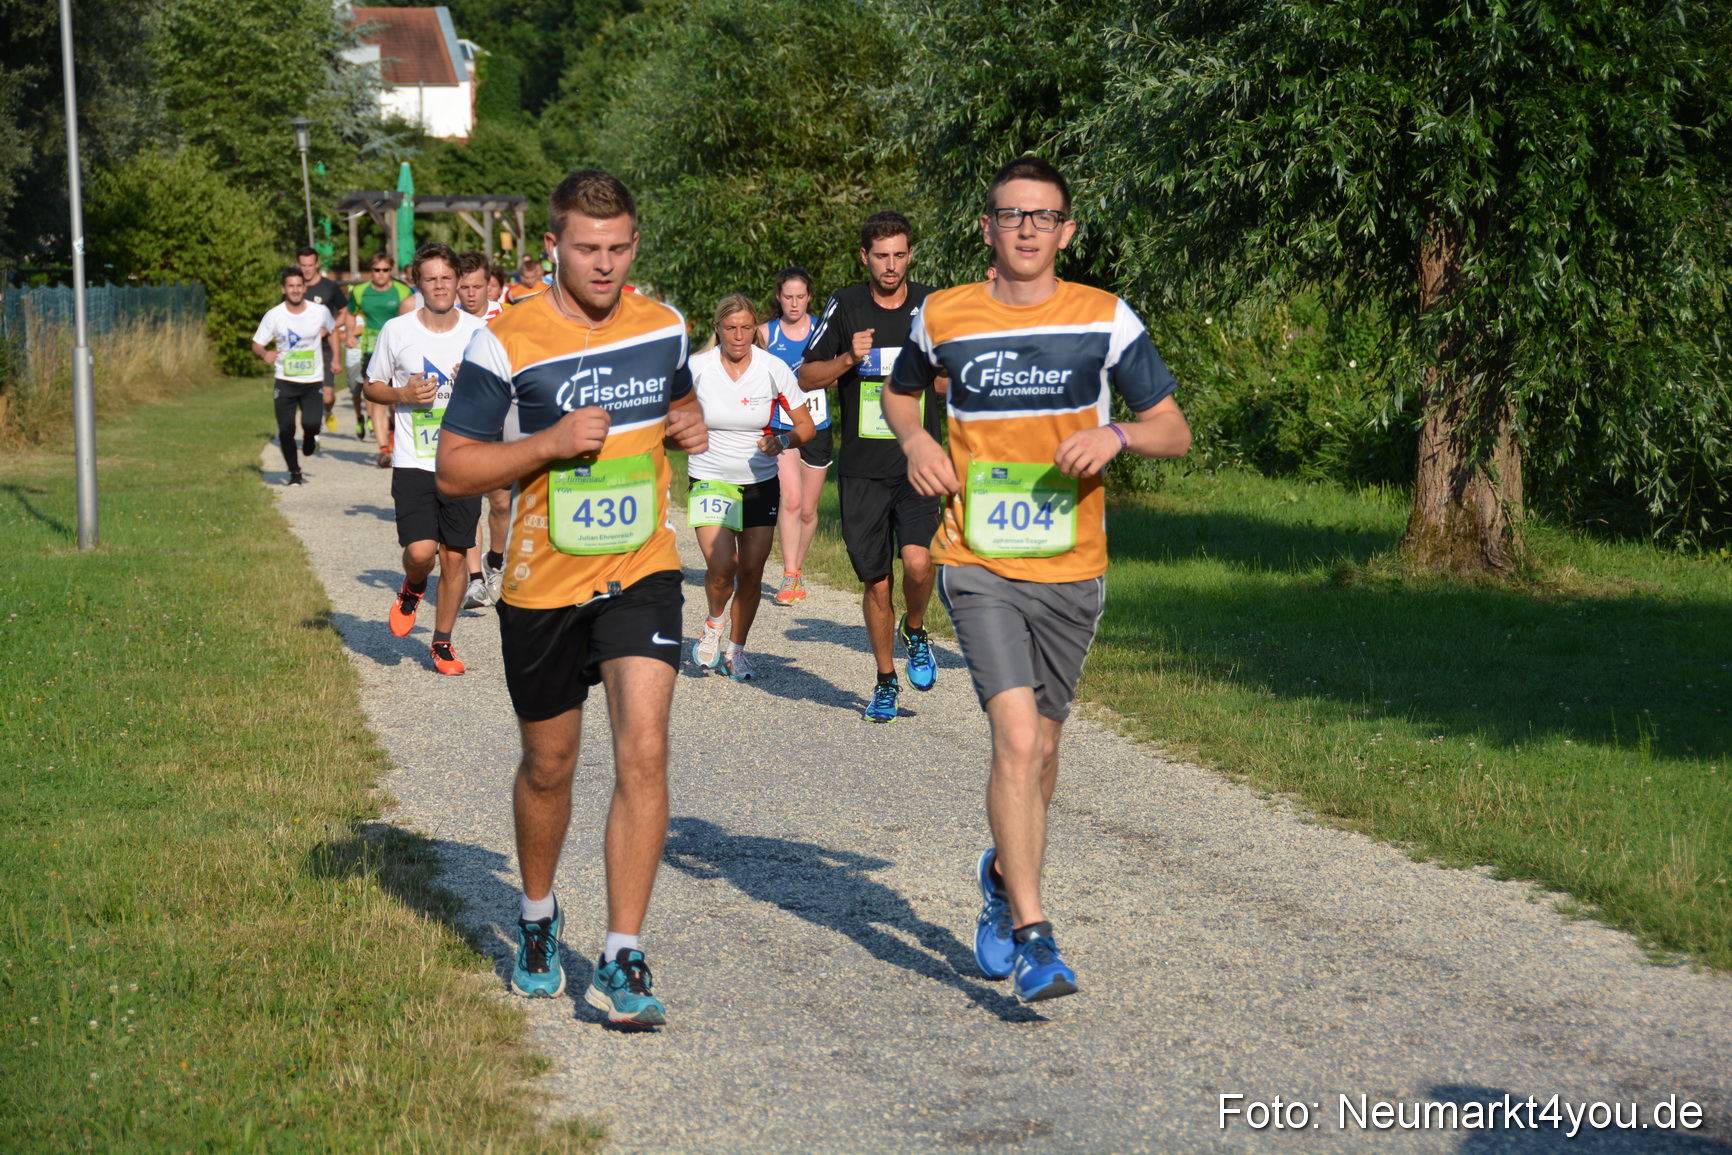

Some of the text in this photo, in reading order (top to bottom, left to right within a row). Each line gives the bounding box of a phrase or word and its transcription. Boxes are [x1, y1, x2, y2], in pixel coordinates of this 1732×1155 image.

[288, 360, 312, 370] 1463
[980, 365, 1072, 387] Fischer
[580, 376, 667, 406] Fischer
[989, 386, 1065, 397] AUTOMOBILE
[598, 393, 664, 411] UTOMOBILE
[805, 396, 819, 412] 41
[572, 495, 637, 528] 430
[700, 498, 732, 515] 157
[987, 500, 1054, 531] 404
